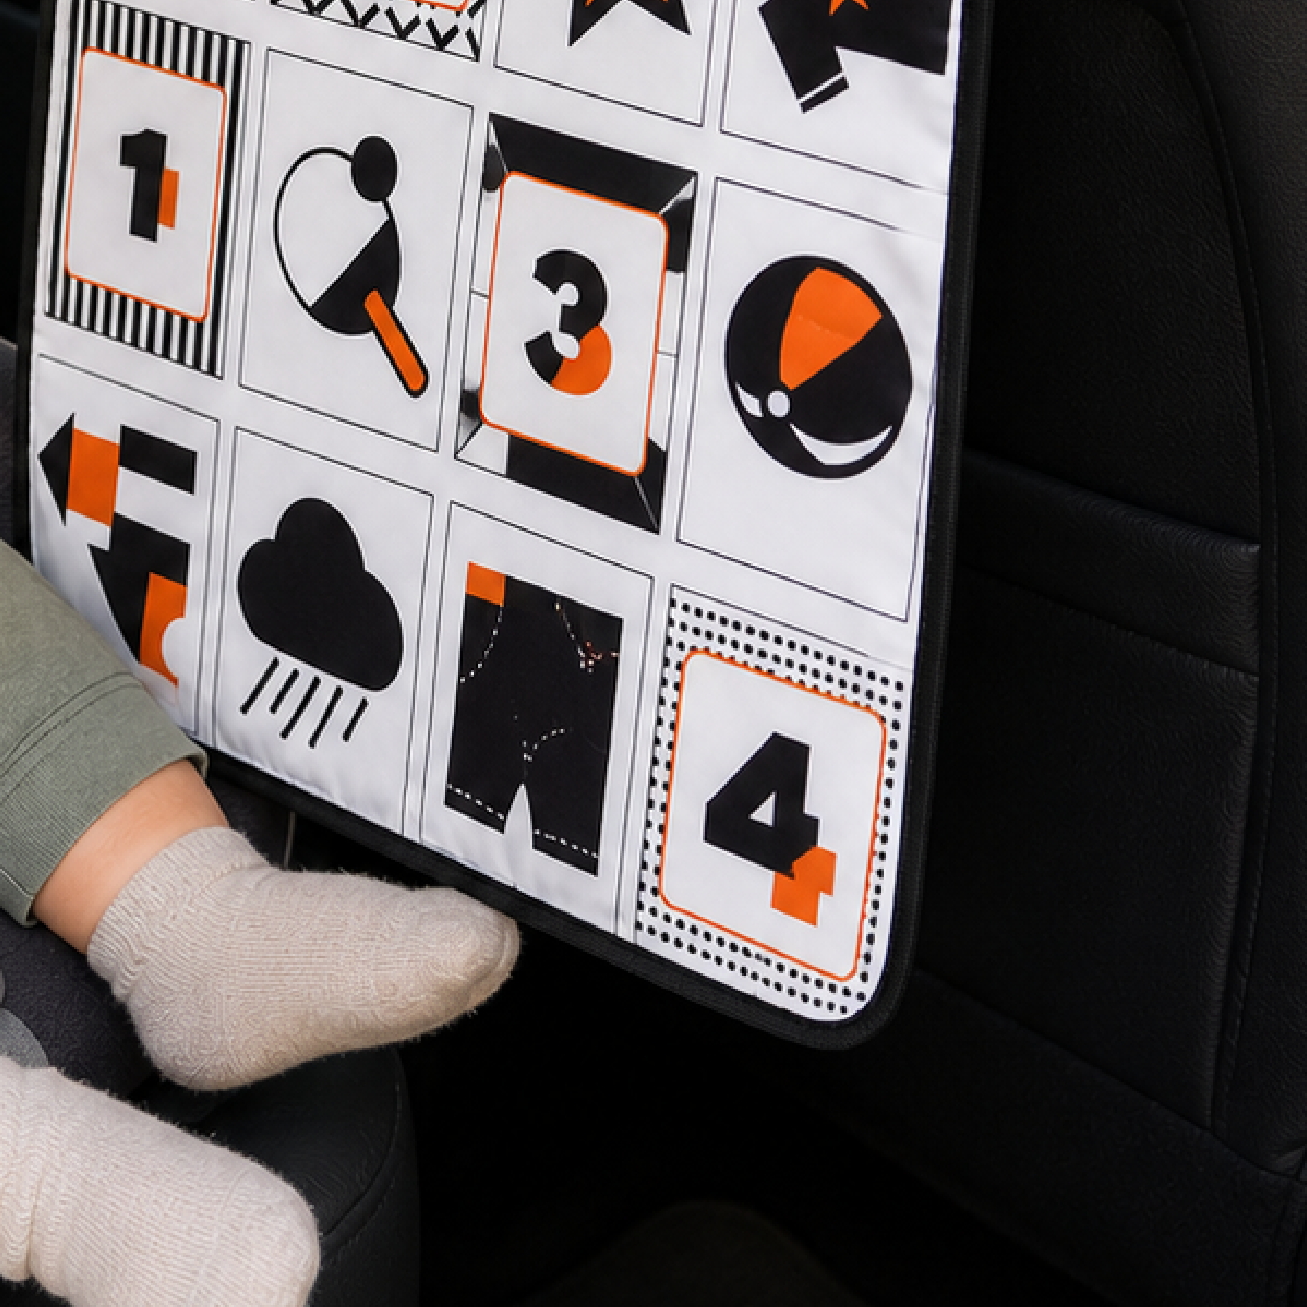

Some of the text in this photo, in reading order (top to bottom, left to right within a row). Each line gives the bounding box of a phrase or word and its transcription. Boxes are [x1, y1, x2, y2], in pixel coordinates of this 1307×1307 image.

[119, 128, 180, 243] 1
[524, 247, 613, 396] 3
[703, 731, 837, 926] 4
